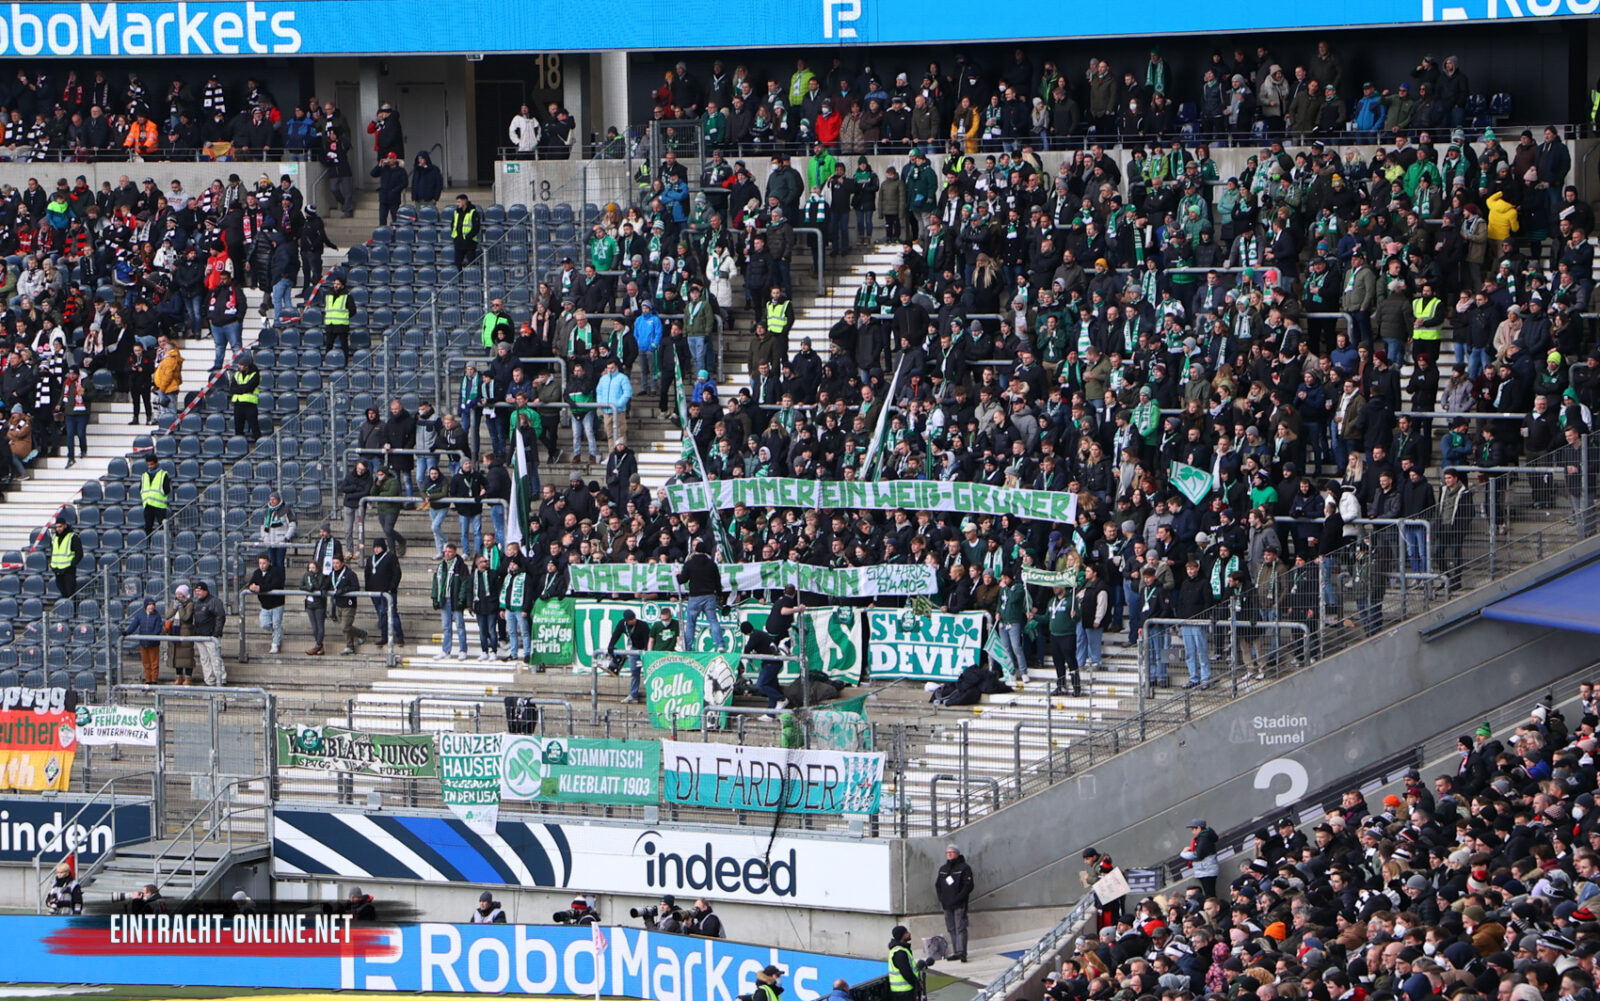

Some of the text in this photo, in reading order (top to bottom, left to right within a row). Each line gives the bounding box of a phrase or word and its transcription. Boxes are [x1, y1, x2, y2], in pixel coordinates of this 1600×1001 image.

[0, 2, 302, 56] boMarkets
[535, 54, 561, 89] 18
[530, 180, 551, 201] 18
[732, 479, 814, 507] IMMER
[821, 481, 867, 507] EIN
[571, 564, 673, 592] MACH'S
[760, 561, 859, 597] AMMON
[538, 623, 572, 642] SpVgg
[530, 639, 561, 656] Fürth
[870, 645, 976, 675] DEVIA
[650, 672, 693, 703] Bella
[95, 713, 138, 727] FEHLPASS
[664, 698, 701, 721] Ciao
[83, 727, 95, 737] DIE
[1253, 714, 1308, 729] Stadion
[441, 734, 502, 755] GUNZEN
[1257, 730, 1305, 745] Tunnel
[443, 757, 502, 777] HAUSEN
[568, 747, 644, 769] STAMMTISCH
[559, 773, 651, 796] KLEEBLATT 1903
[675, 747, 840, 812] DI FÄRDDER
[644, 840, 797, 897] indeed
